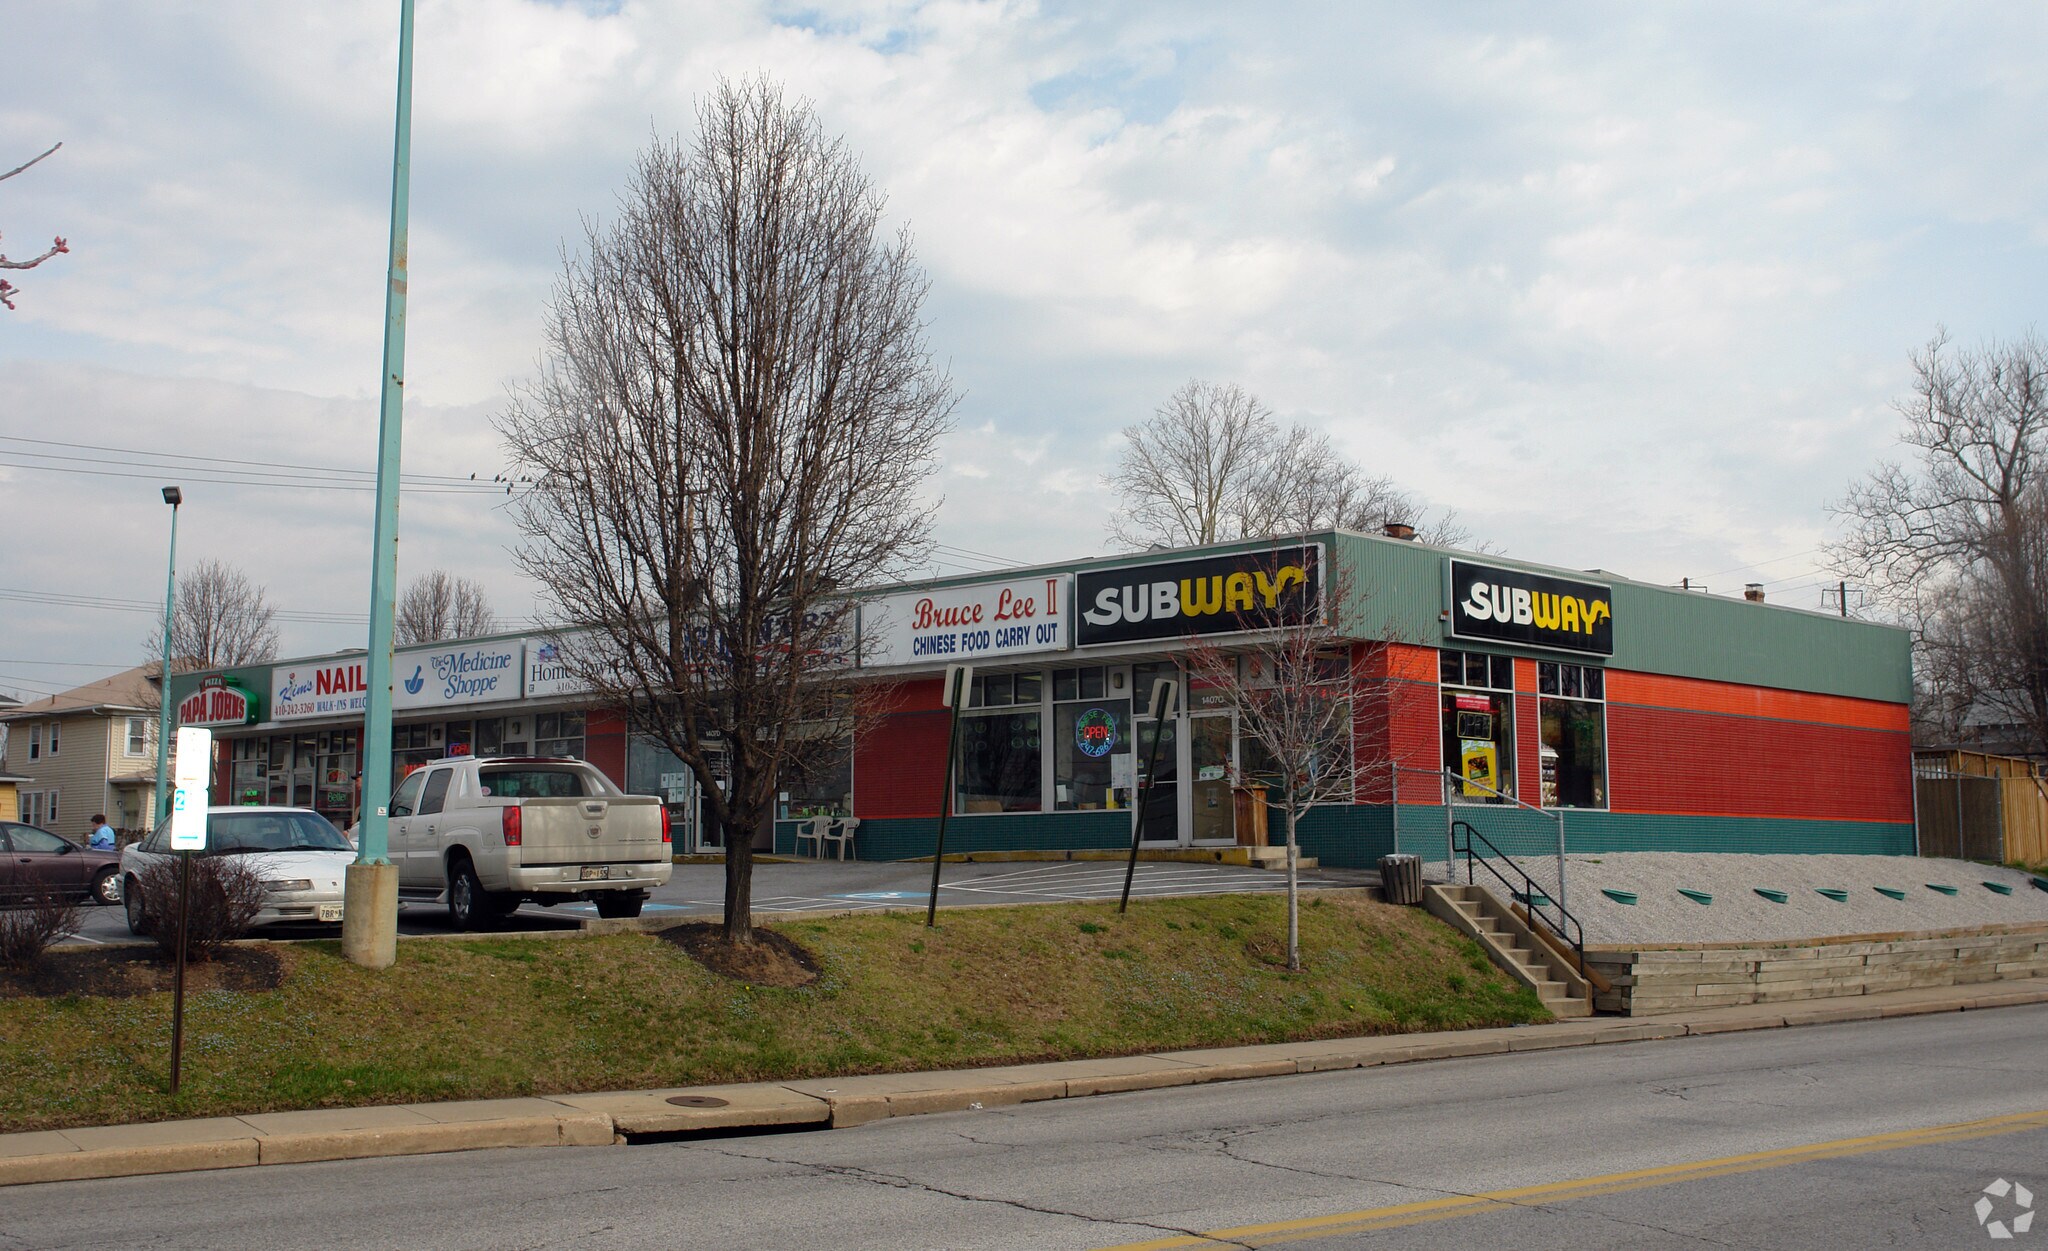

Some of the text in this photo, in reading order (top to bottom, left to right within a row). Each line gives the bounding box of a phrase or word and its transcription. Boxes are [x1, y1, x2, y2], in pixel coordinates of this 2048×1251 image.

[912, 598, 984, 630] Bruce
[994, 588, 1036, 621] Lee
[1082, 565, 1309, 626] SUBWAY
[1461, 582, 1611, 635] SUBWAY
[913, 622, 1058, 656] CHINESE FOOD CARRY OUT
[431, 650, 512, 680] The Medicine
[204, 678, 222, 687] PIZZA
[444, 673, 499, 699] Shoppe
[181, 693, 207, 723] PAPA
[317, 699, 347, 712] WALK-INS
[1083, 726, 1108, 739] OPEN
